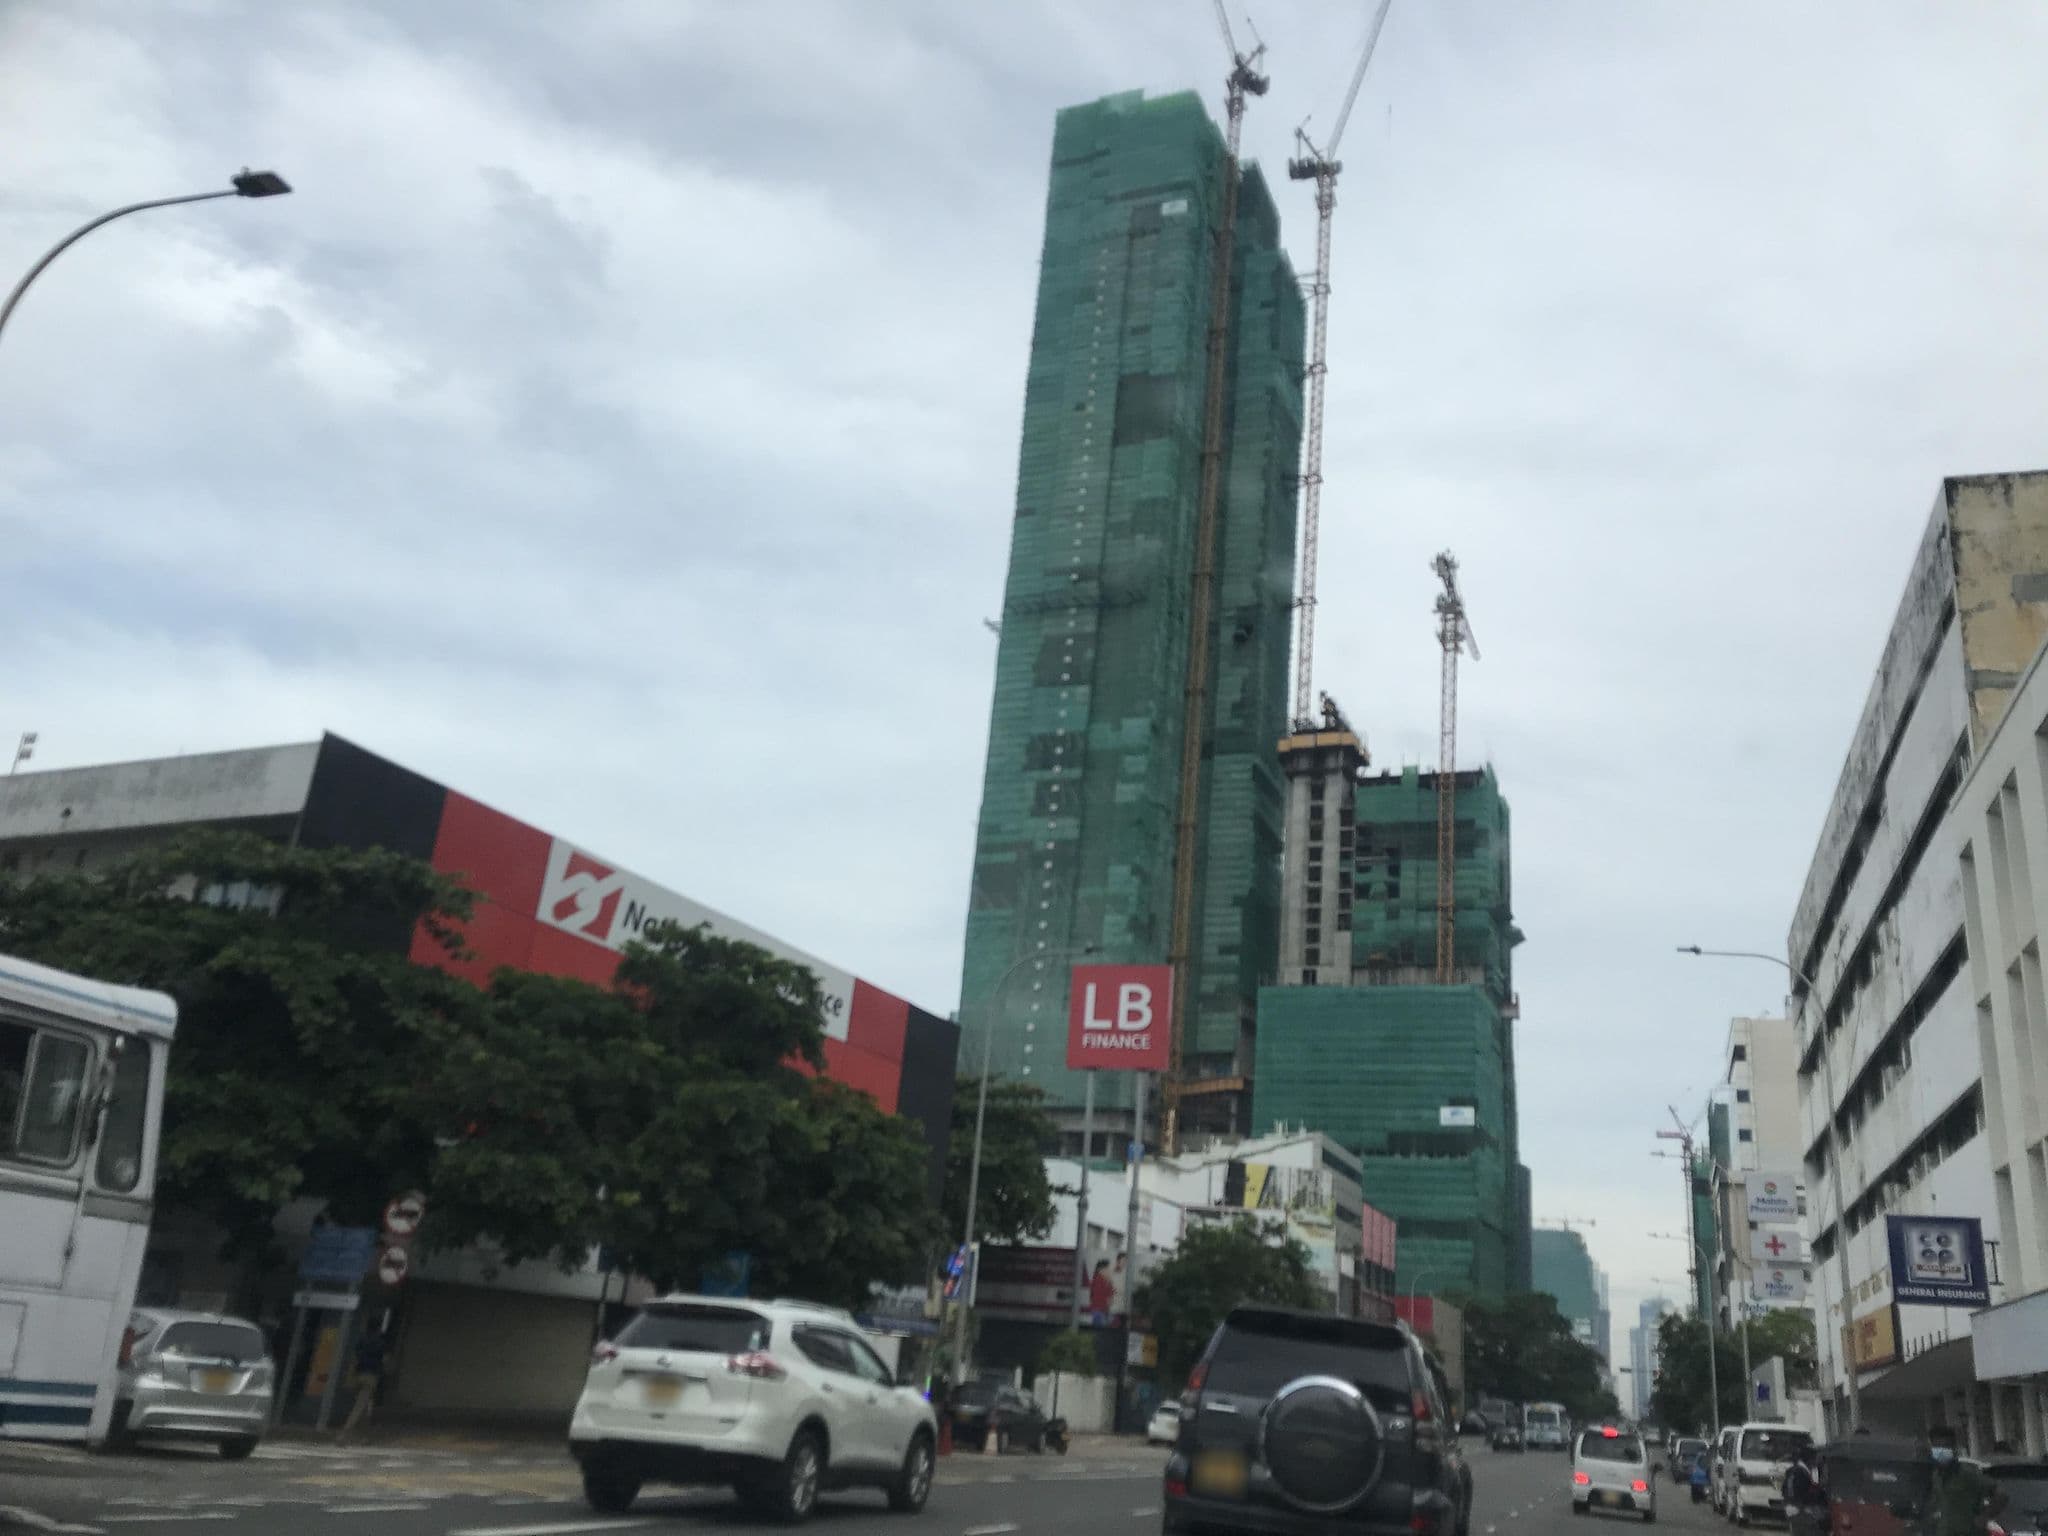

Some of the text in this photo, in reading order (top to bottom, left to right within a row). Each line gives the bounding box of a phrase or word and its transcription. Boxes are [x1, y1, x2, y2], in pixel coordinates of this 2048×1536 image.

[1084, 982, 1153, 1032] LB
[1082, 1033, 1152, 1050] FINANCE
[1897, 1287, 1986, 1300] GENERAL INSURANCE
